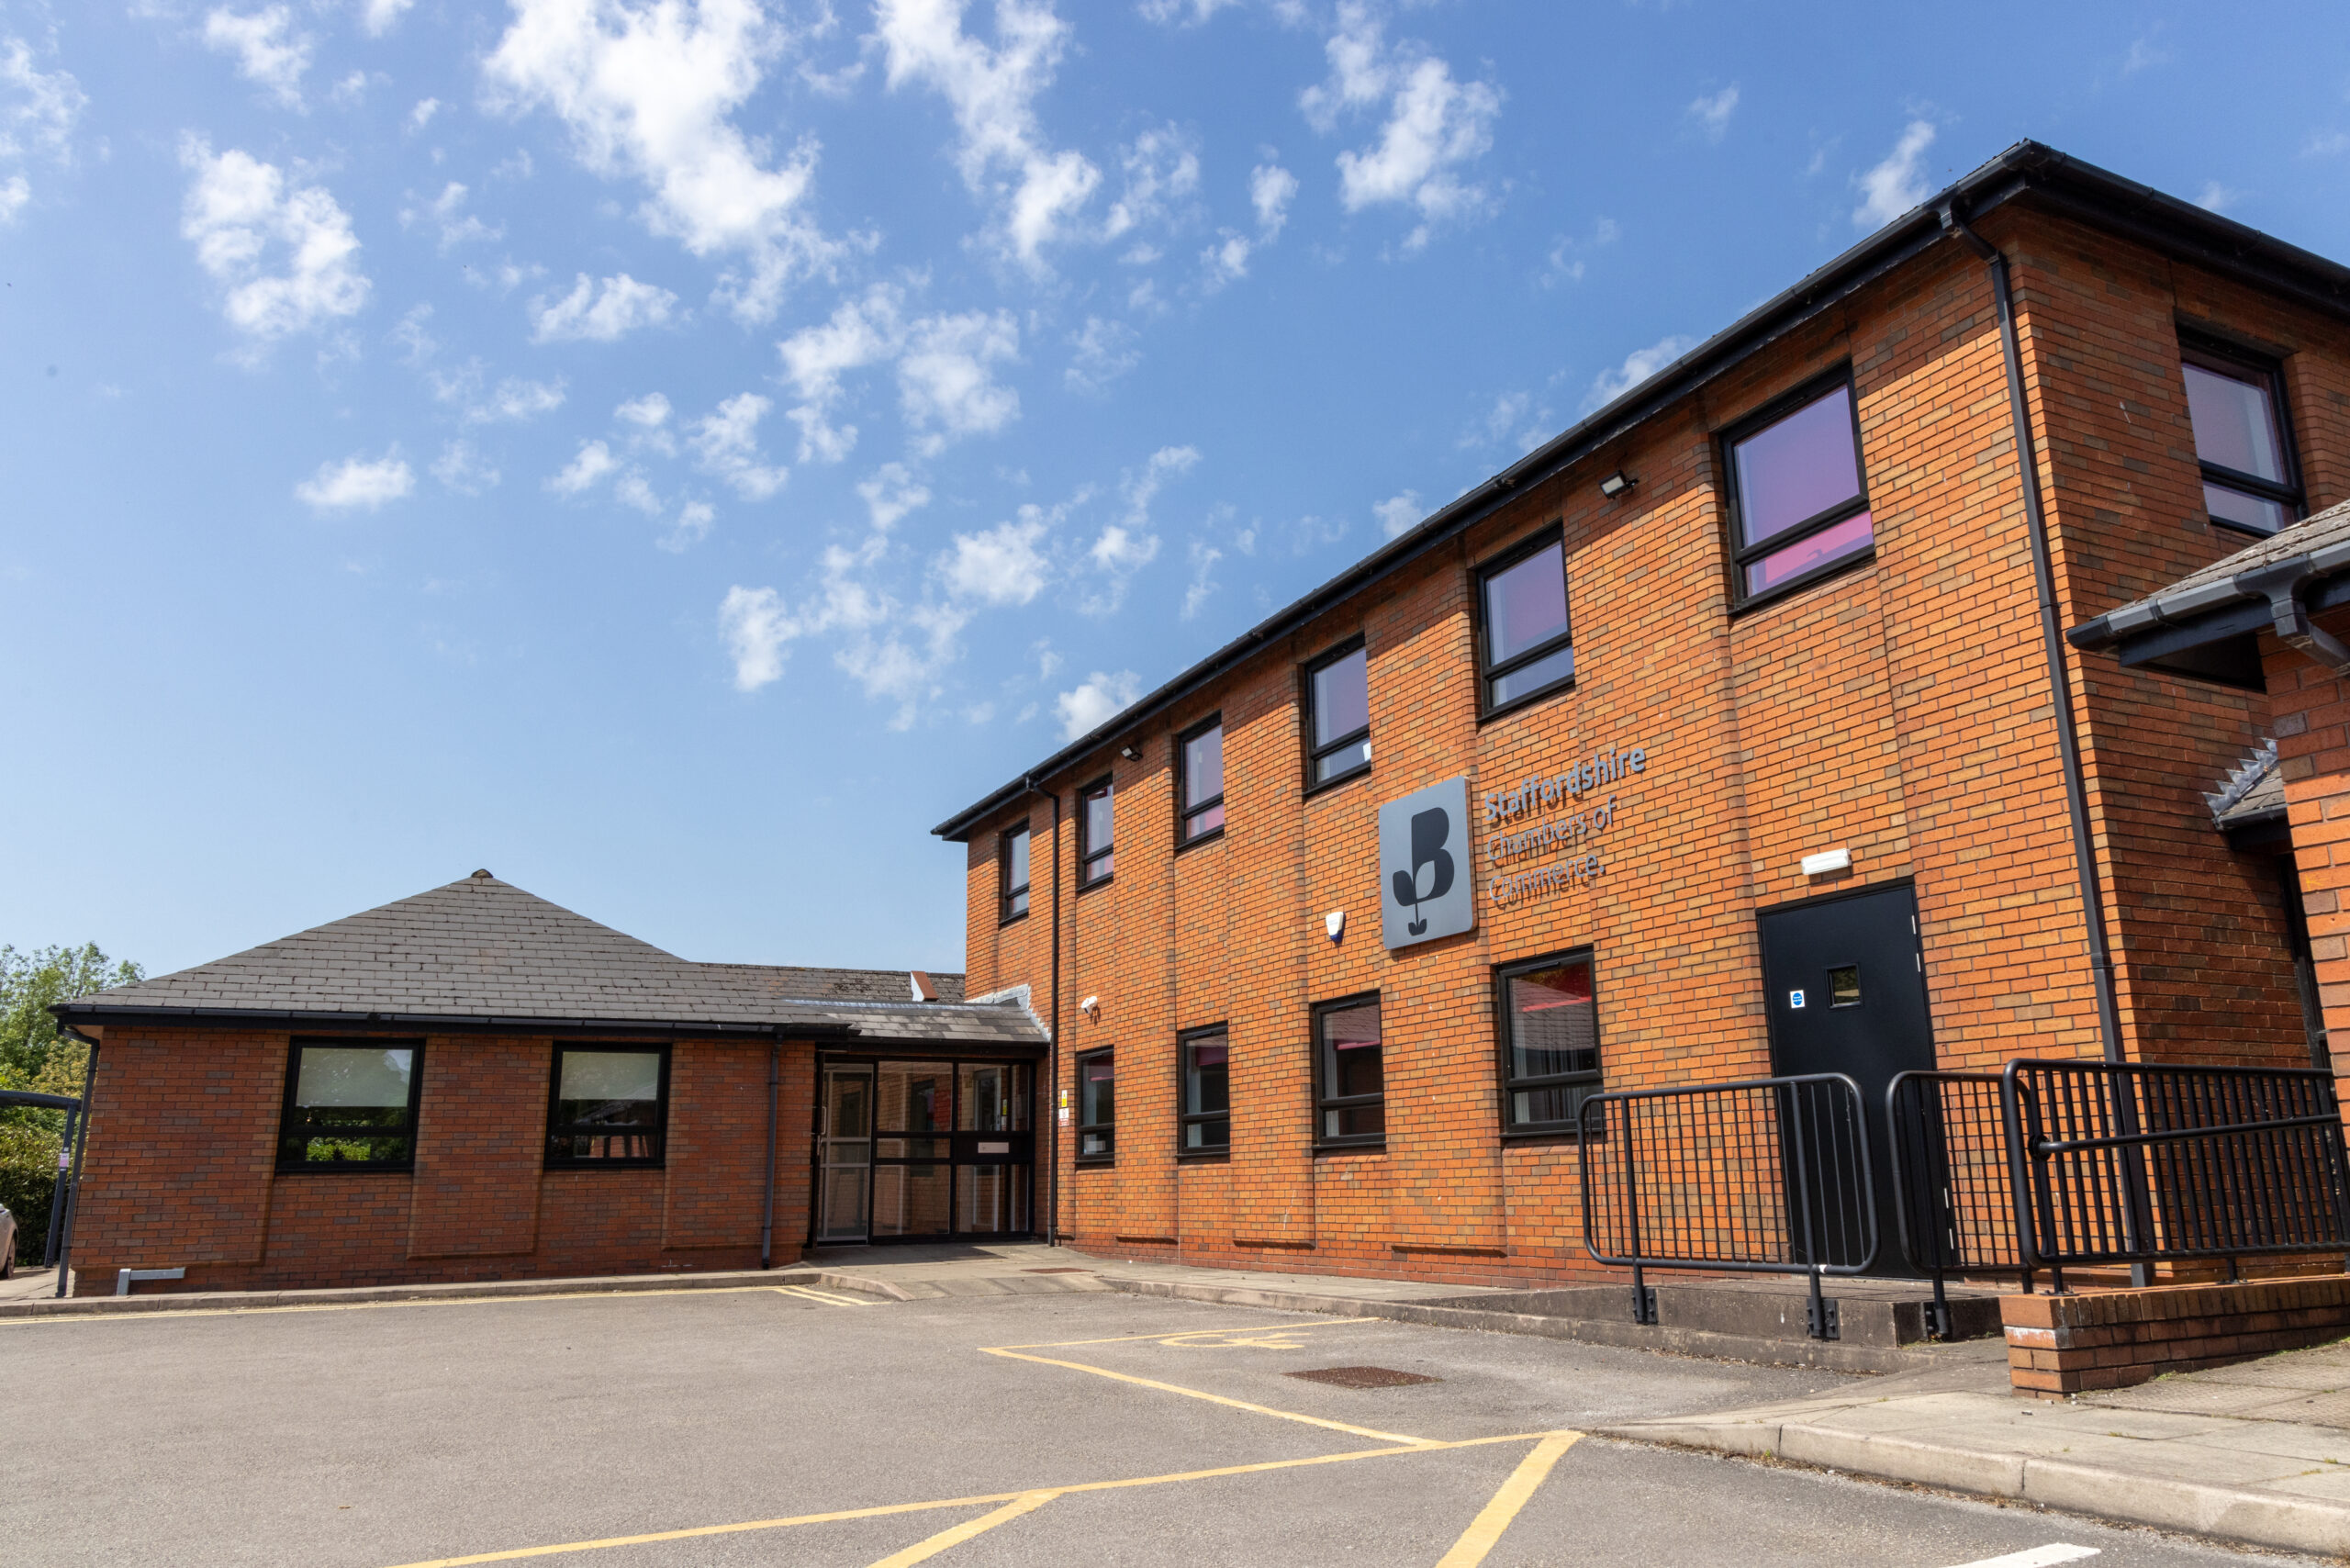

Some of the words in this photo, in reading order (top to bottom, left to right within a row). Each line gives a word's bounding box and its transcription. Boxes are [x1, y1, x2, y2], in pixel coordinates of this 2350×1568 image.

[1484, 747, 1646, 821] Staffordshire
[1487, 813, 1587, 860] Chambers
[1593, 794, 1617, 829] of
[1489, 855, 1605, 901] Commerce.
